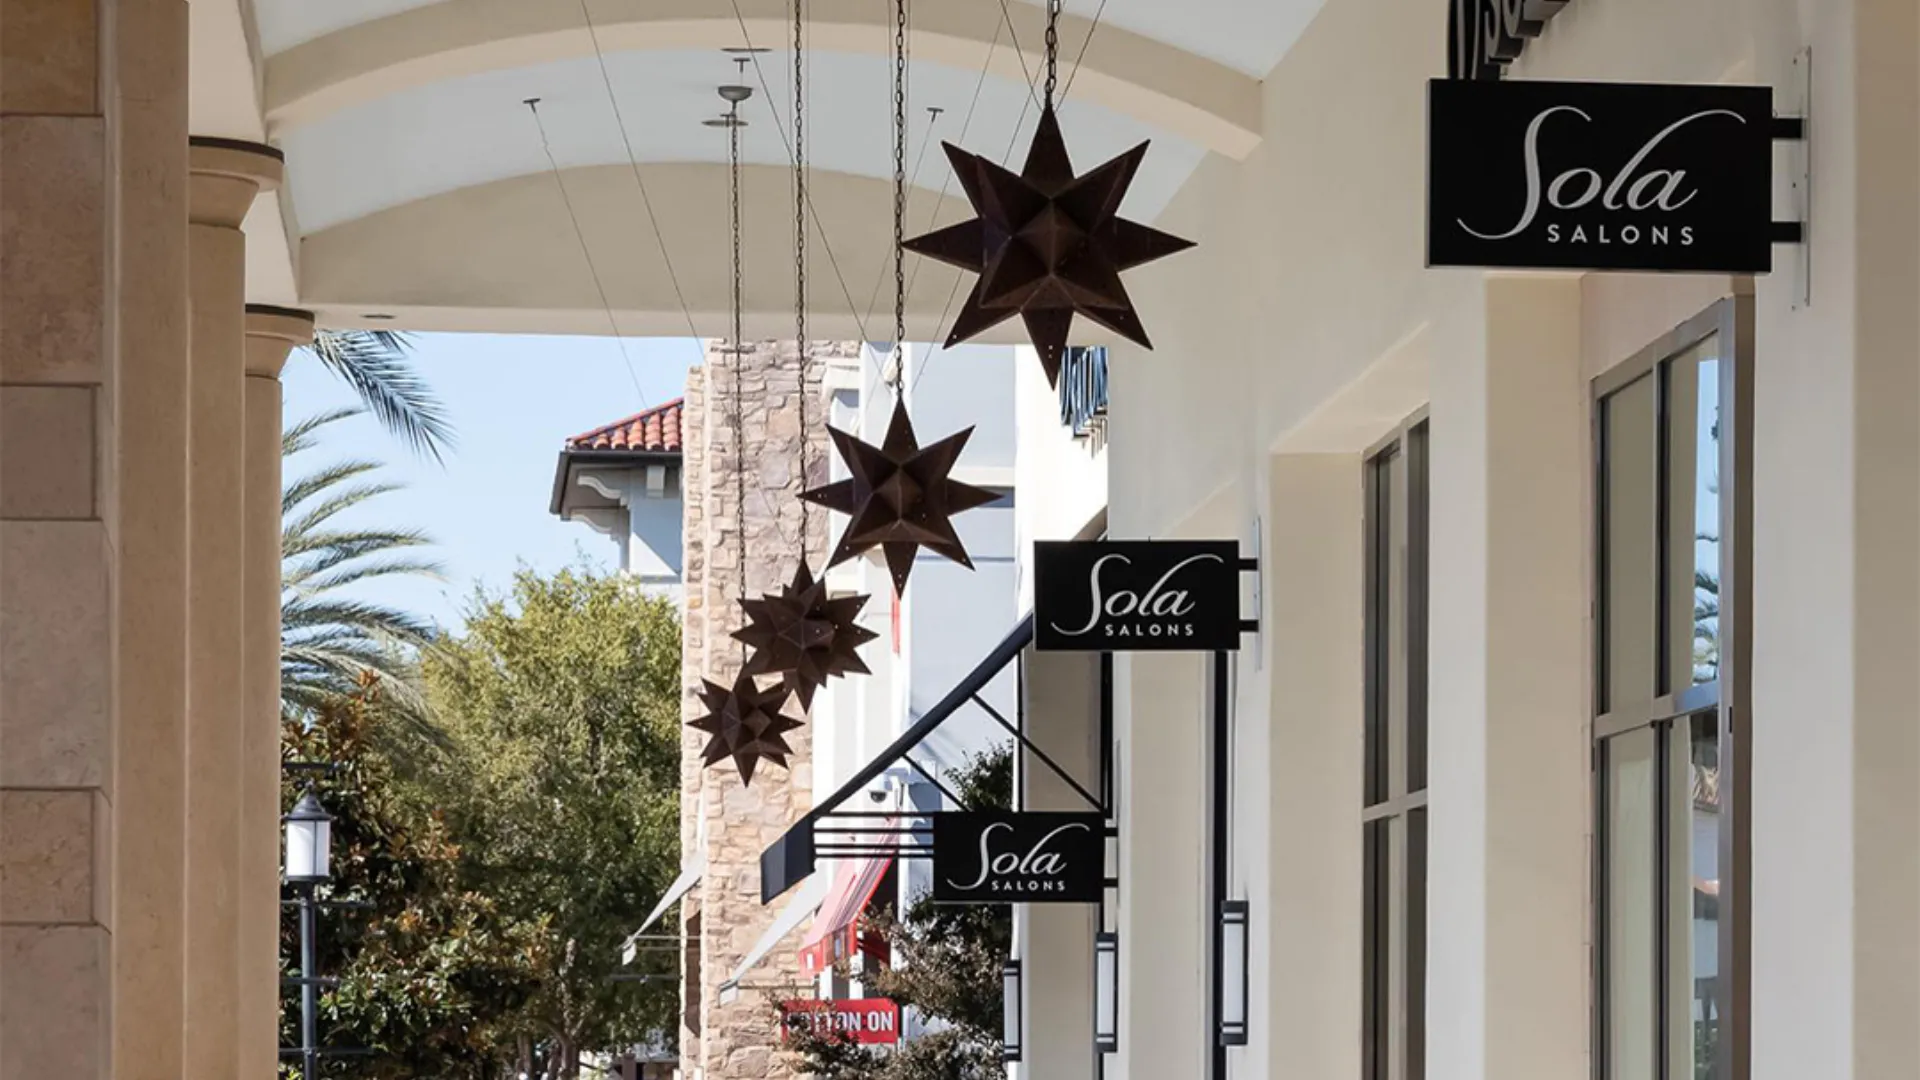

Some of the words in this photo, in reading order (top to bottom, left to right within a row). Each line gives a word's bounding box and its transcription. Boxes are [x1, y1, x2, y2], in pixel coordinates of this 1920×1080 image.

[1458, 105, 1746, 240] Sola
[1547, 223, 1694, 246] SALONS
[1051, 553, 1224, 635] Sola
[1104, 623, 1194, 637] SALONS
[947, 822, 1090, 890] Sola
[991, 880, 1065, 891] SALONS
[867, 1010, 893, 1032] ON
